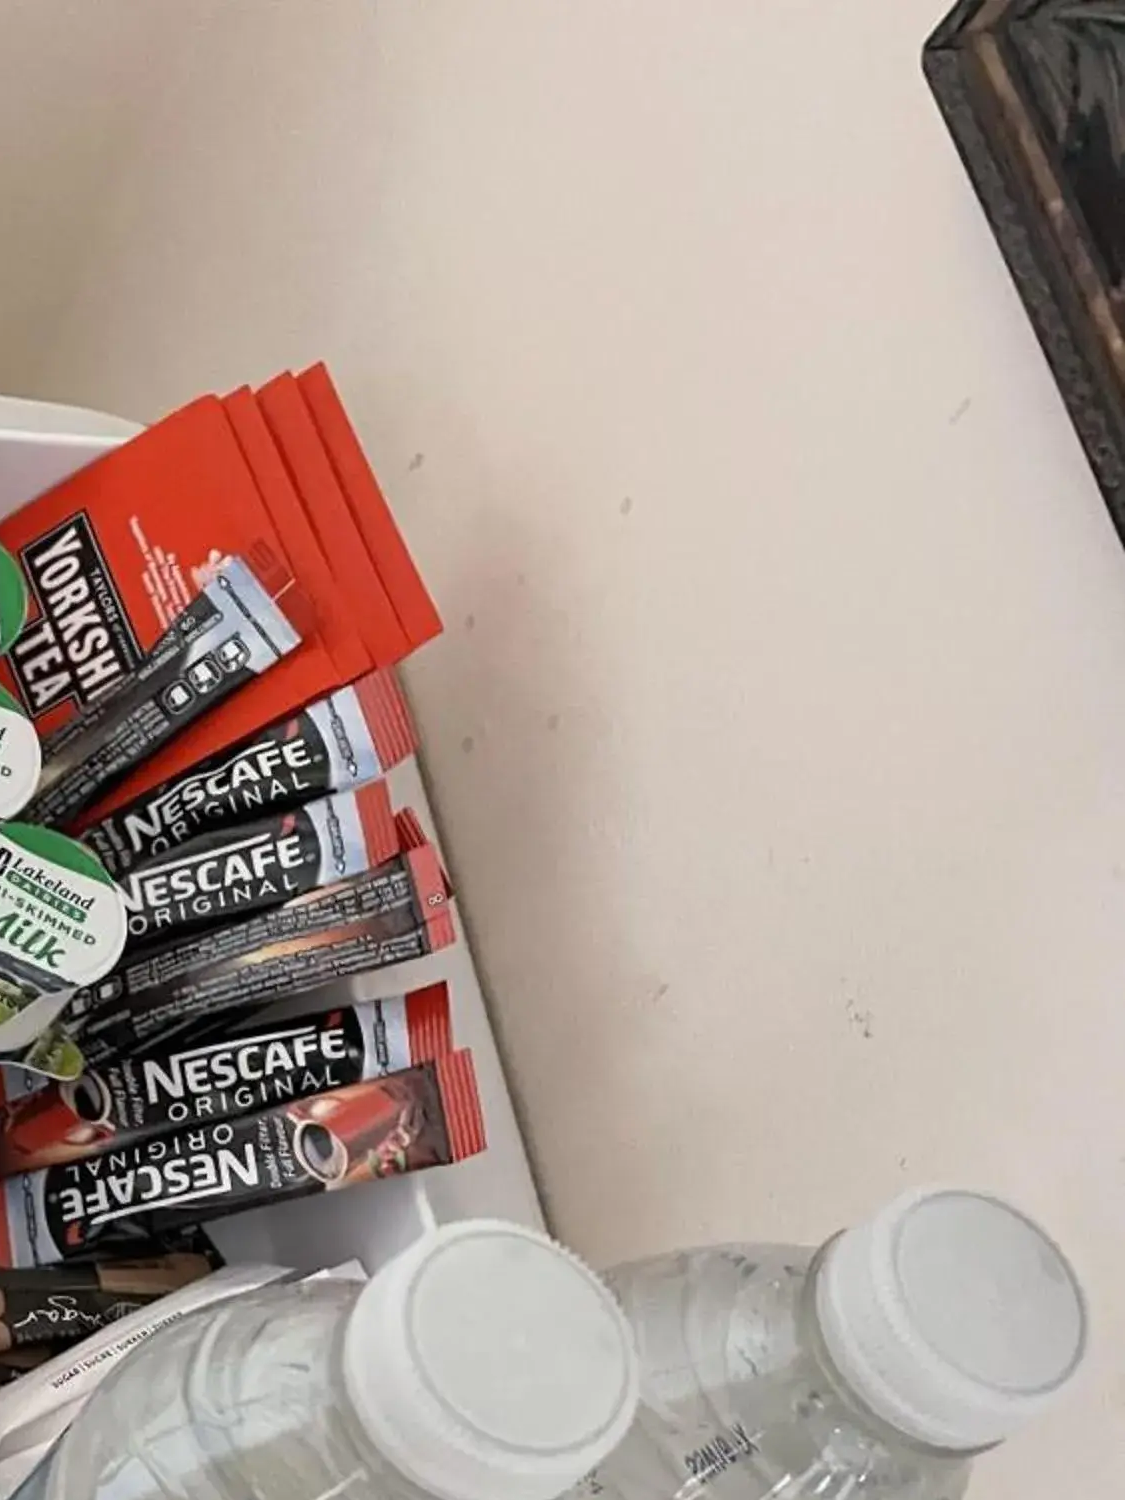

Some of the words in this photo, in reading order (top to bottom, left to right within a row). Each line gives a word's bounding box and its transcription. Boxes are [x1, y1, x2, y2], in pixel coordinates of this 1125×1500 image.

[89, 567, 118, 625] TAYLORS
[15, 622, 72, 708] TEA
[150, 772, 311, 857] ORIGINAL
[12, 856, 95, 911] Lakeland
[128, 872, 299, 935] ORIGINAL
[167, 1064, 341, 1122] ORIGINAL
[66, 1122, 235, 1183] ORIGINAL
